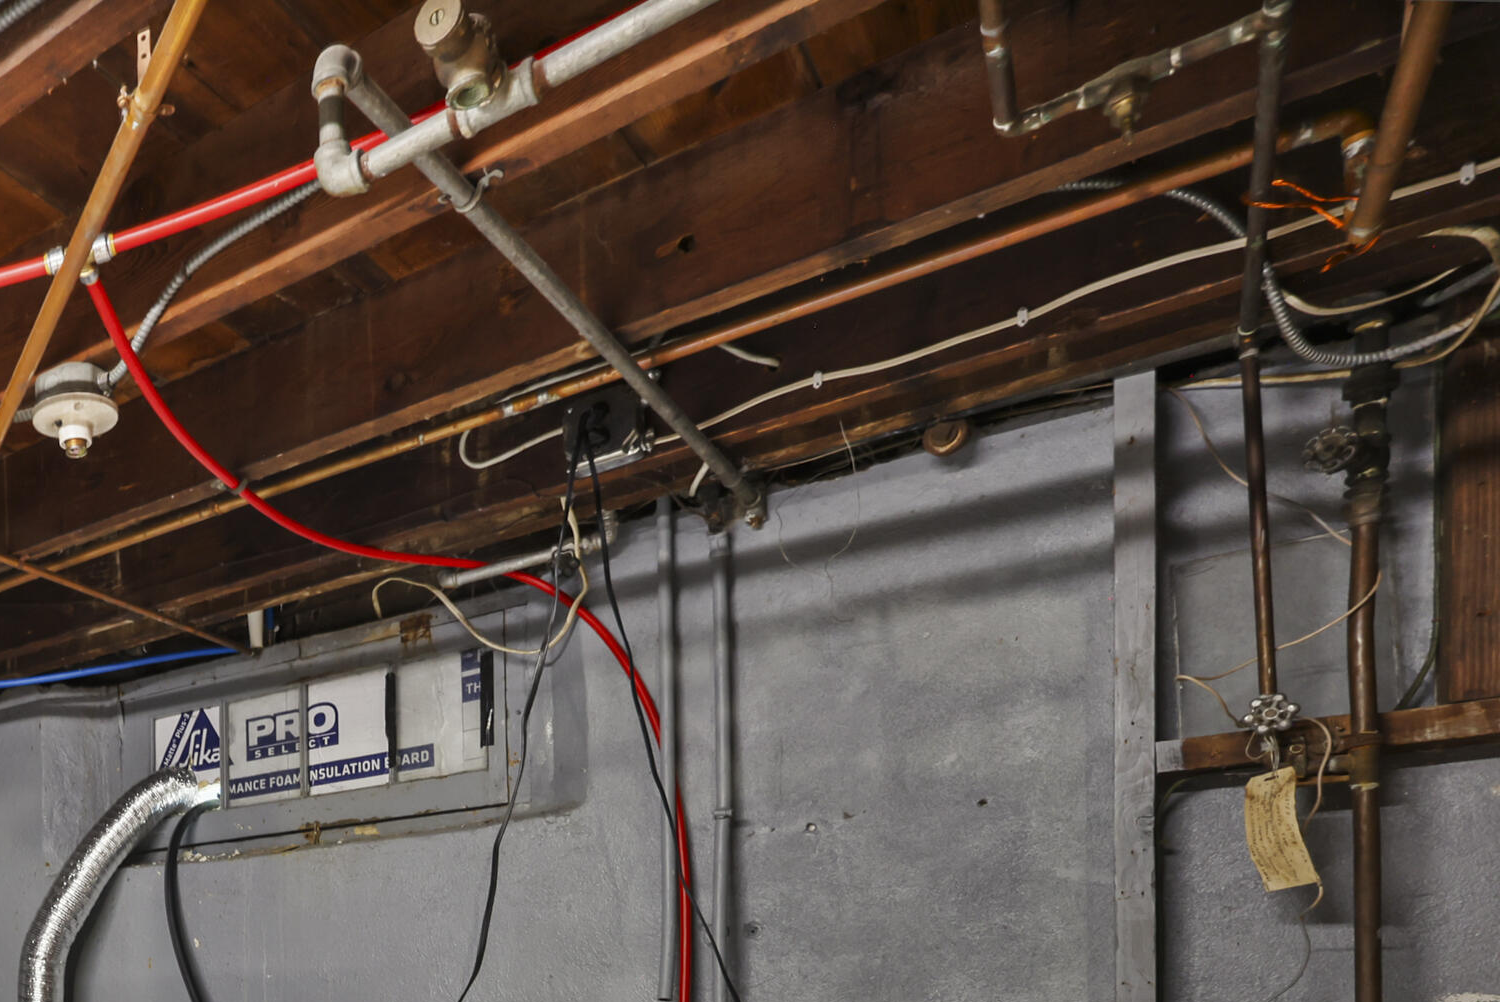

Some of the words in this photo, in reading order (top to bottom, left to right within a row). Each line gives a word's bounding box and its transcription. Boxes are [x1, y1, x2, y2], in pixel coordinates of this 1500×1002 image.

[247, 703, 337, 747] PRO
[179, 728, 220, 768] Sika
[254, 736, 330, 759] SELECT
[309, 758, 380, 781] NSULATION
